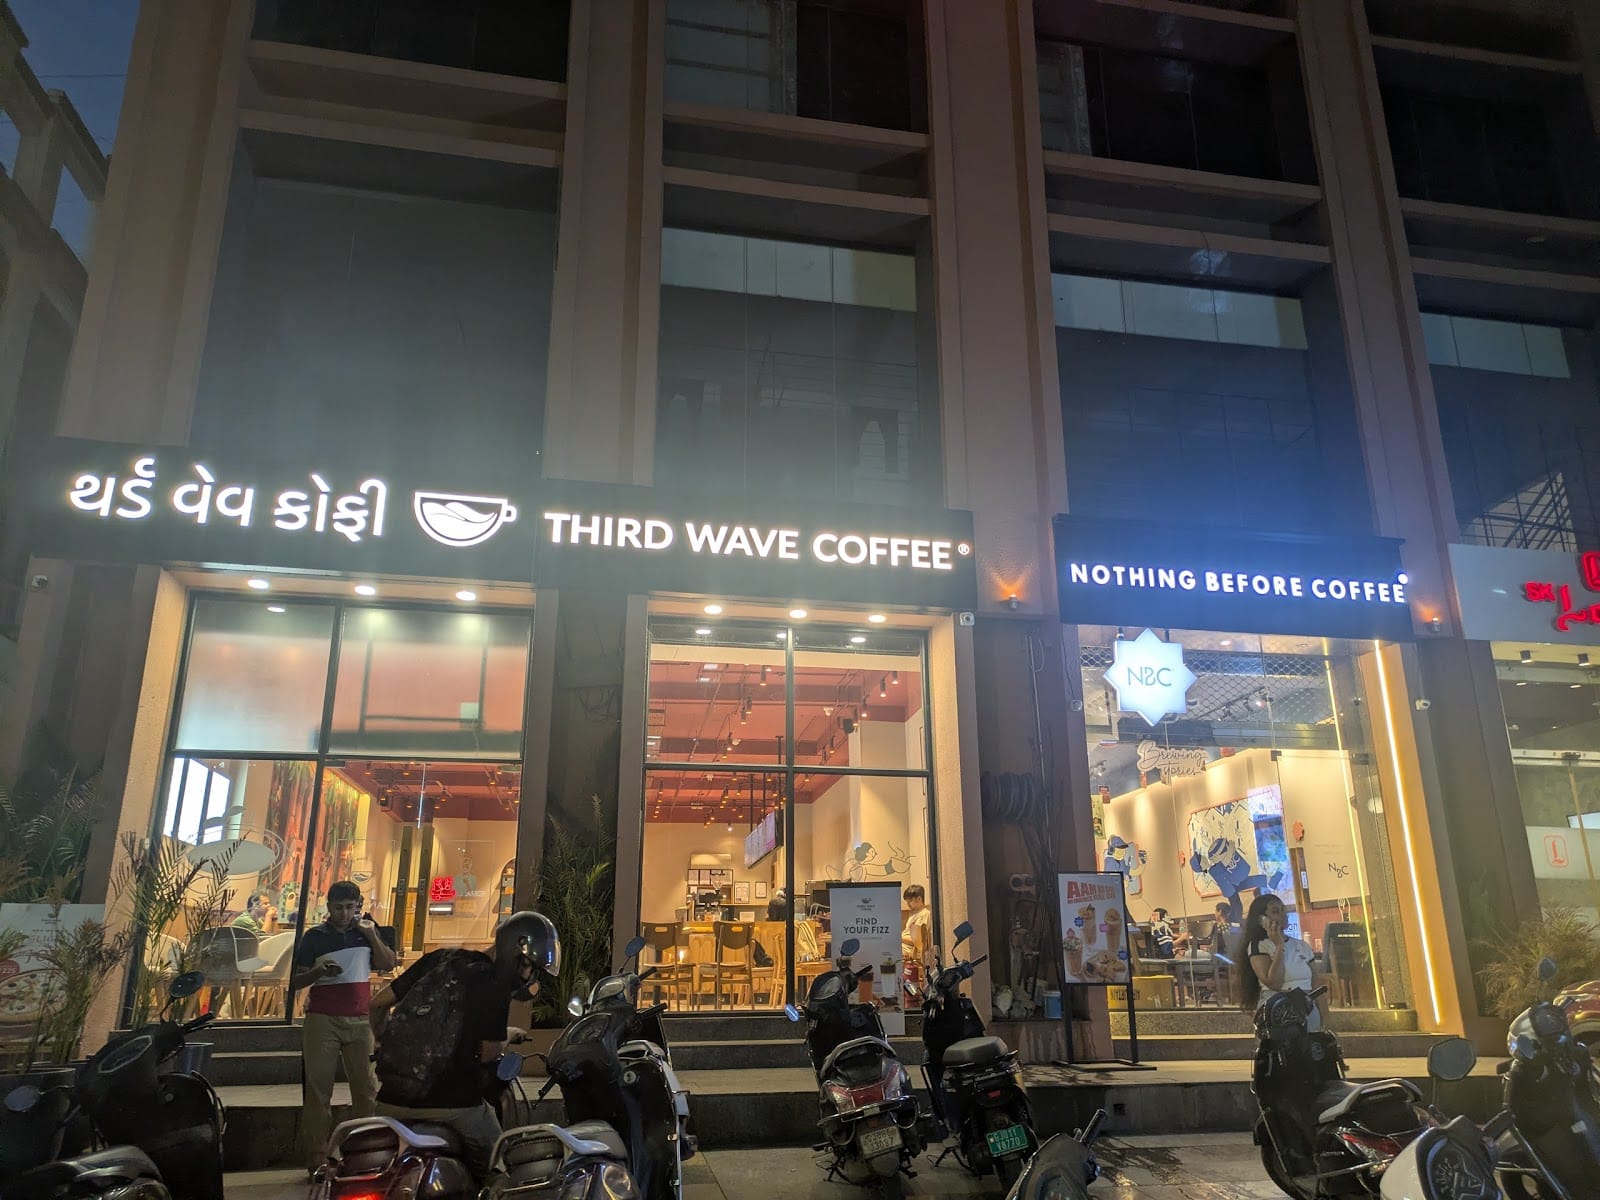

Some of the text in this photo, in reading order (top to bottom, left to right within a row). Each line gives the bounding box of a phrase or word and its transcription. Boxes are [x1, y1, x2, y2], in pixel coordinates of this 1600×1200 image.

[70, 457, 387, 542] થર્ડ વેવ કોફી
[543, 512, 674, 550] THIRD
[685, 522, 799, 560] WAVE
[812, 533, 953, 570] COFFEE
[1070, 562, 1405, 603] NOTHING BEFORE COFFEE
[843, 926, 889, 934] YOUR FIZZ
[855, 917, 878, 925] FIND
